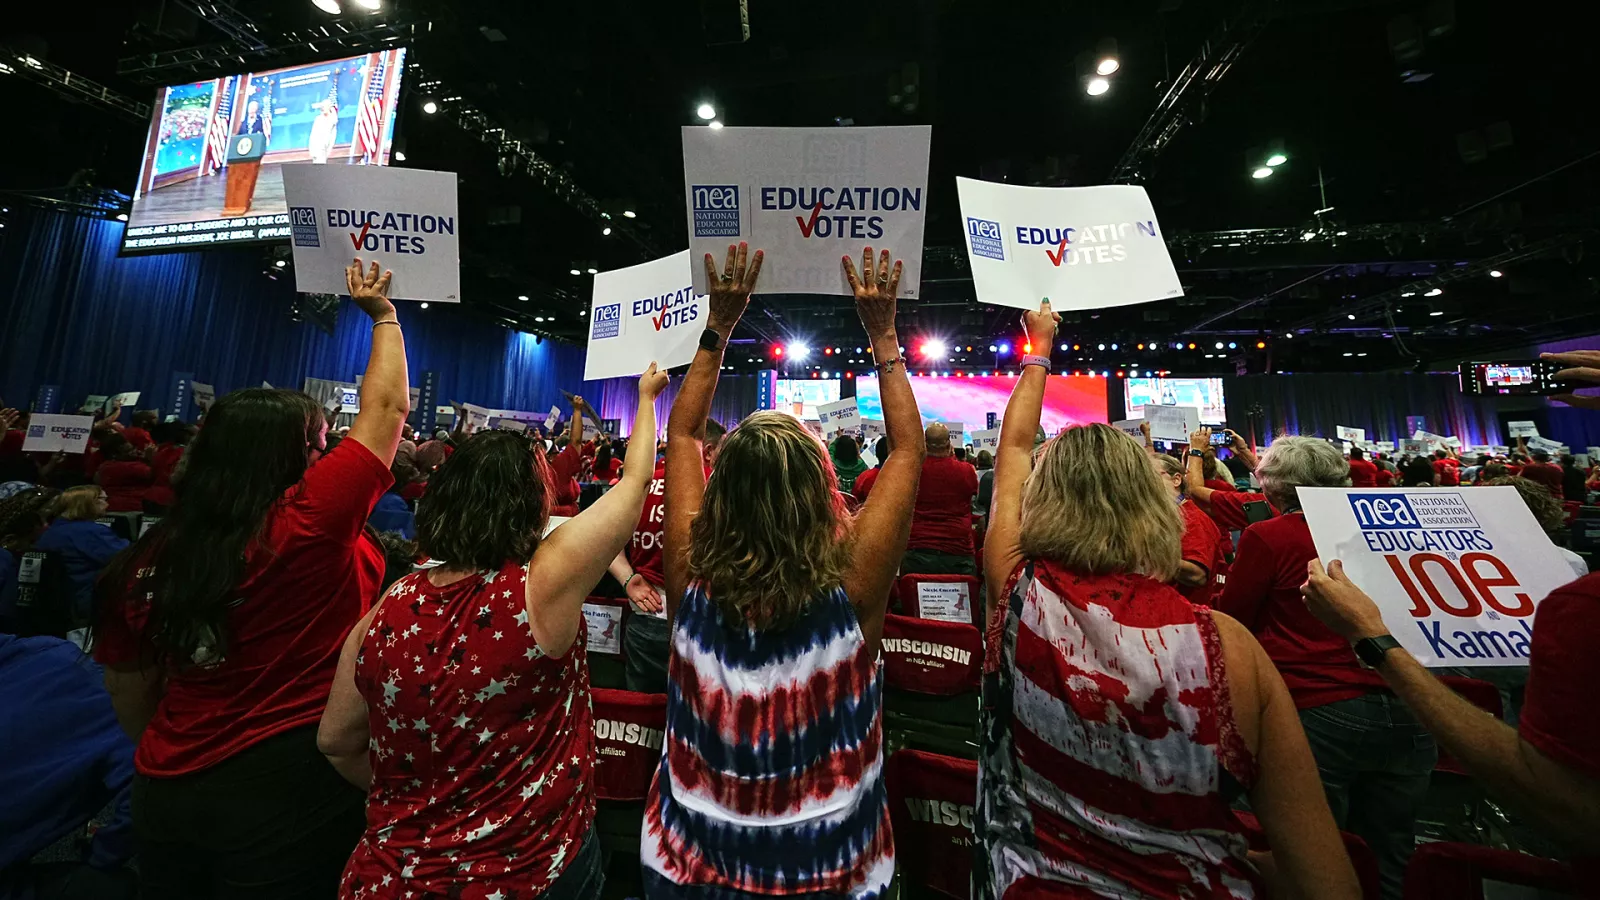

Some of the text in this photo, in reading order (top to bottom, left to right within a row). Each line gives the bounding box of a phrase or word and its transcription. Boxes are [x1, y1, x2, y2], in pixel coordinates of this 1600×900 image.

[695, 188, 737, 210] nea
[761, 187, 922, 211] EDUCATION
[291, 208, 316, 226] nea
[327, 209, 454, 235] EDUCATION
[695, 212, 738, 220] NATIONAL
[168, 224, 178, 233] TO
[247, 217, 256, 226] TO
[257, 216, 274, 225] OUR
[696, 220, 738, 228] EDUCATION
[795, 208, 884, 239] VOTES
[969, 218, 1000, 240] nea
[697, 228, 739, 236] ASSOCIATION
[350, 226, 425, 255] VOTES
[971, 237, 1002, 247] NATIONAL
[972, 243, 1003, 253] EDUCATION
[973, 249, 1004, 260] ASSOCIATION
[1046, 241, 1128, 267] VOTES
[633, 286, 704, 316] EDUCAT
[595, 304, 619, 322] nea
[652, 306, 698, 332] VOTES
[594, 321, 619, 329] NATIONAL
[421, 372, 433, 430] TENNESSEE
[830, 405, 858, 417] EDUCATION
[837, 411, 853, 420] VOTES
[51, 426, 90, 434] EDUCATION
[61, 432, 82, 440] VOTES
[1410, 498, 1462, 506] NATIONAL
[1354, 498, 1417, 526] nea
[1416, 507, 1468, 516] EDUCATION
[1422, 516, 1473, 525] ASSOCIATION
[1362, 530, 1493, 552] EDUCATORS
[1446, 552, 1459, 561] FOR
[1486, 611, 1501, 620] AND
[881, 639, 972, 666] WISCONSIN
[913, 657, 926, 665] NEA
[593, 718, 664, 750] ONSIN
[600, 747, 626, 757] affiliate
[904, 797, 974, 829] WISC
